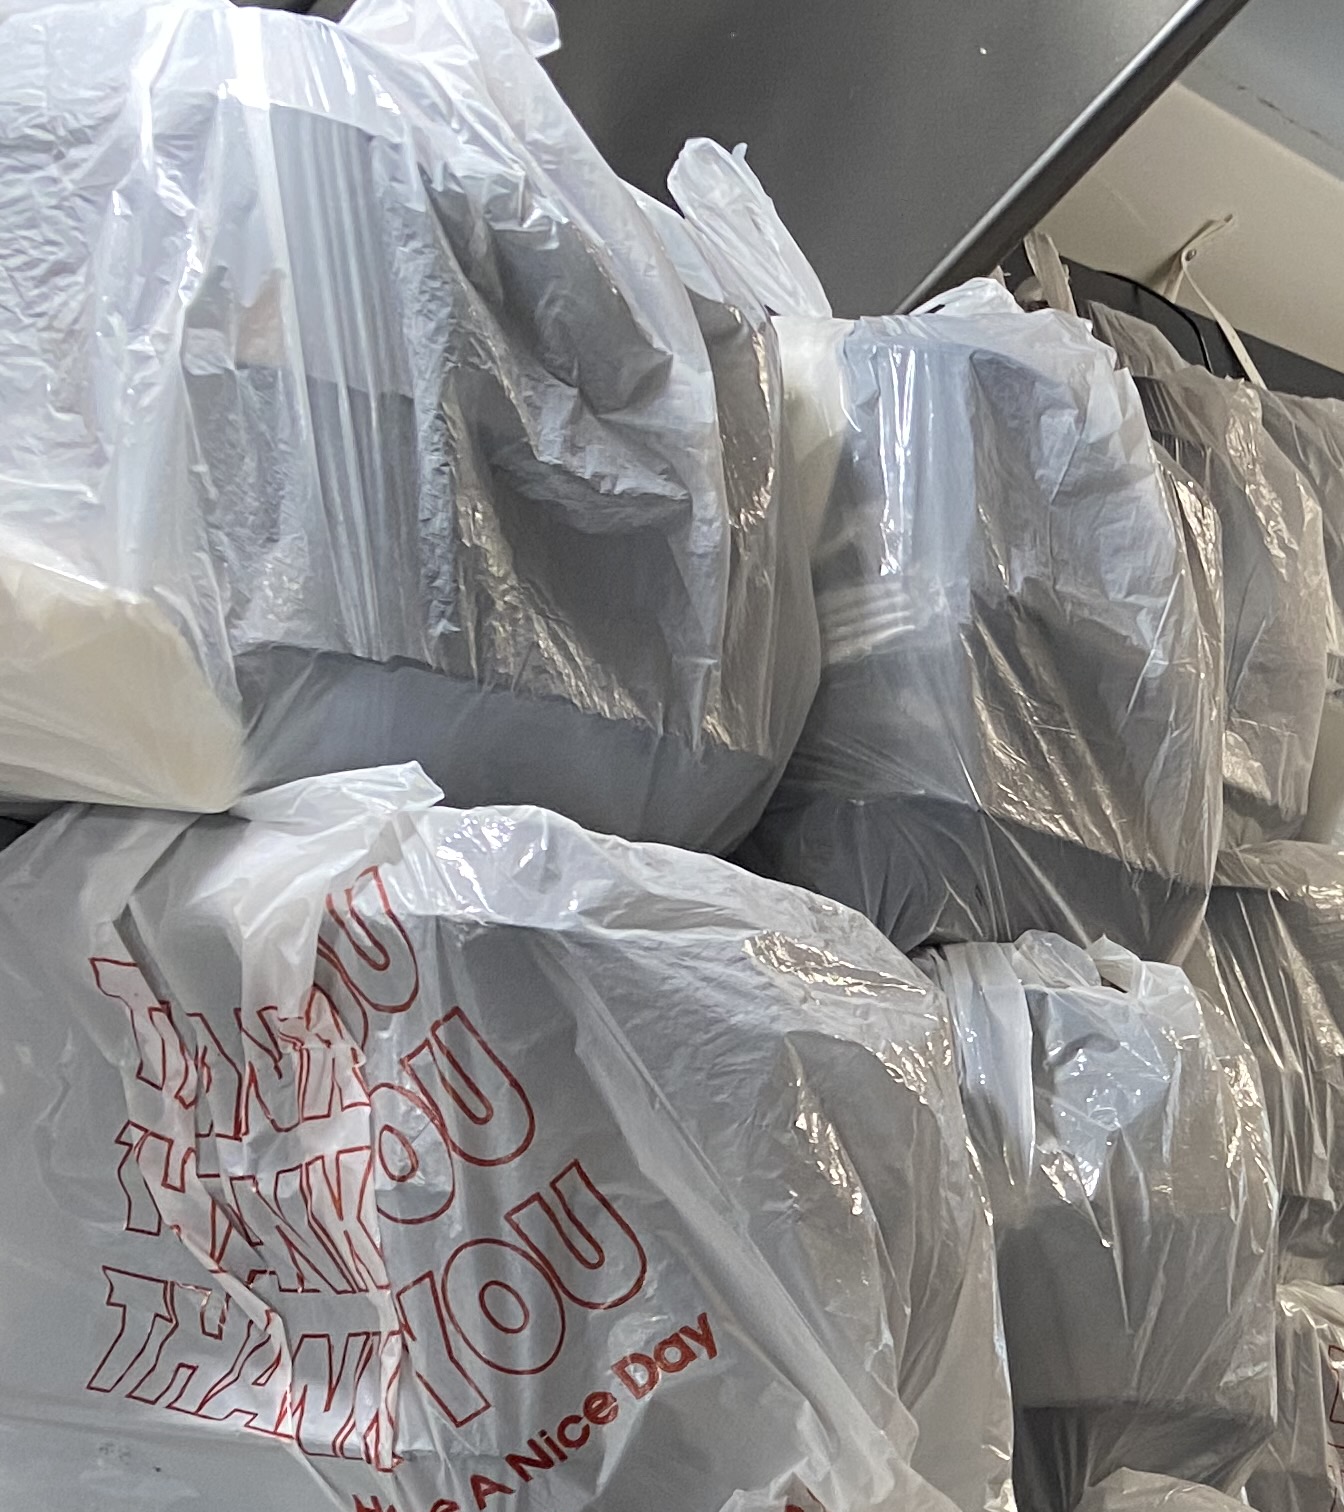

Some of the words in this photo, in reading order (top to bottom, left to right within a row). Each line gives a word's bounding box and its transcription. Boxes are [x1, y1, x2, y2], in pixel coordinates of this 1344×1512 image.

[468, 1473, 516, 1512] A
[503, 1390, 620, 1492] Nice
[611, 1312, 723, 1401] Day
